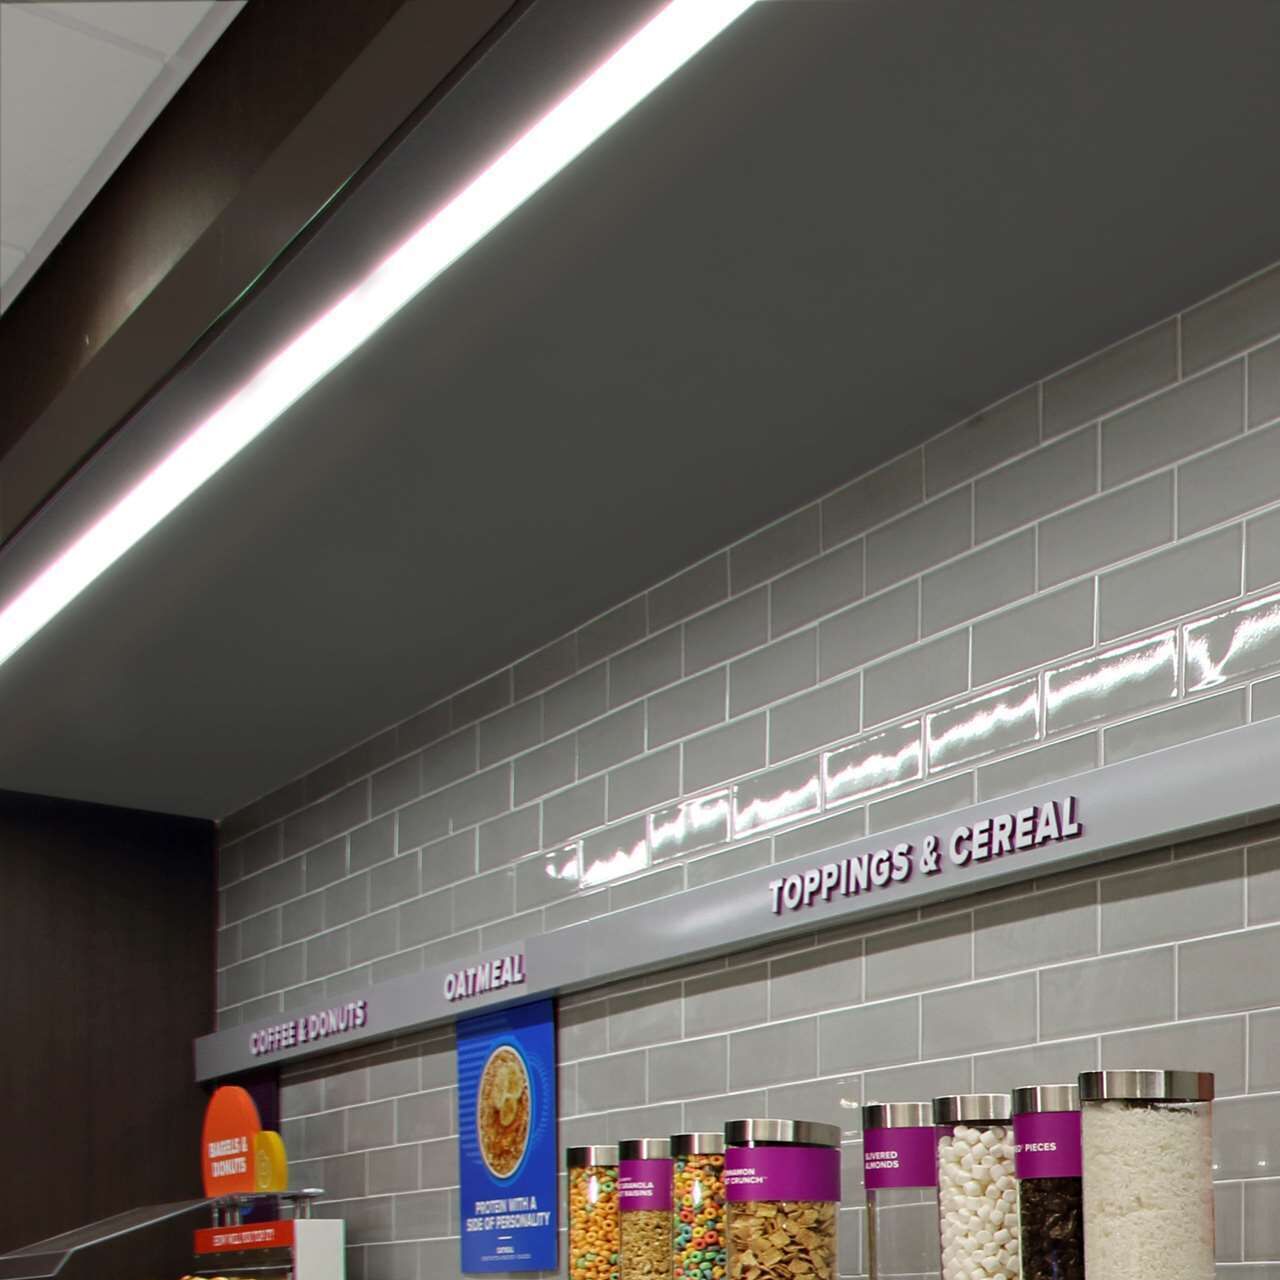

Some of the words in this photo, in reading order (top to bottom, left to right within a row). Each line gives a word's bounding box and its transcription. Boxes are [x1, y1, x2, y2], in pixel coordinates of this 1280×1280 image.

[769, 842, 913, 914] TOPPINGS
[919, 835, 941, 874] &
[949, 796, 1083, 866] CEREAL
[444, 954, 526, 1002] OATMEAL
[249, 1021, 297, 1055] COFFEE
[308, 1000, 368, 1041] DONUTS
[1025, 1143, 1056, 1152] PIECES
[211, 1156, 247, 1177] DONUTS
[475, 1199, 507, 1215] PROTEIN
[508, 1196, 529, 1212] WITH
[530, 1195, 538, 1210] A
[466, 1217, 483, 1232] SIDE
[484, 1216, 495, 1230] OF
[495, 1211, 551, 1230] PERSONALITY
